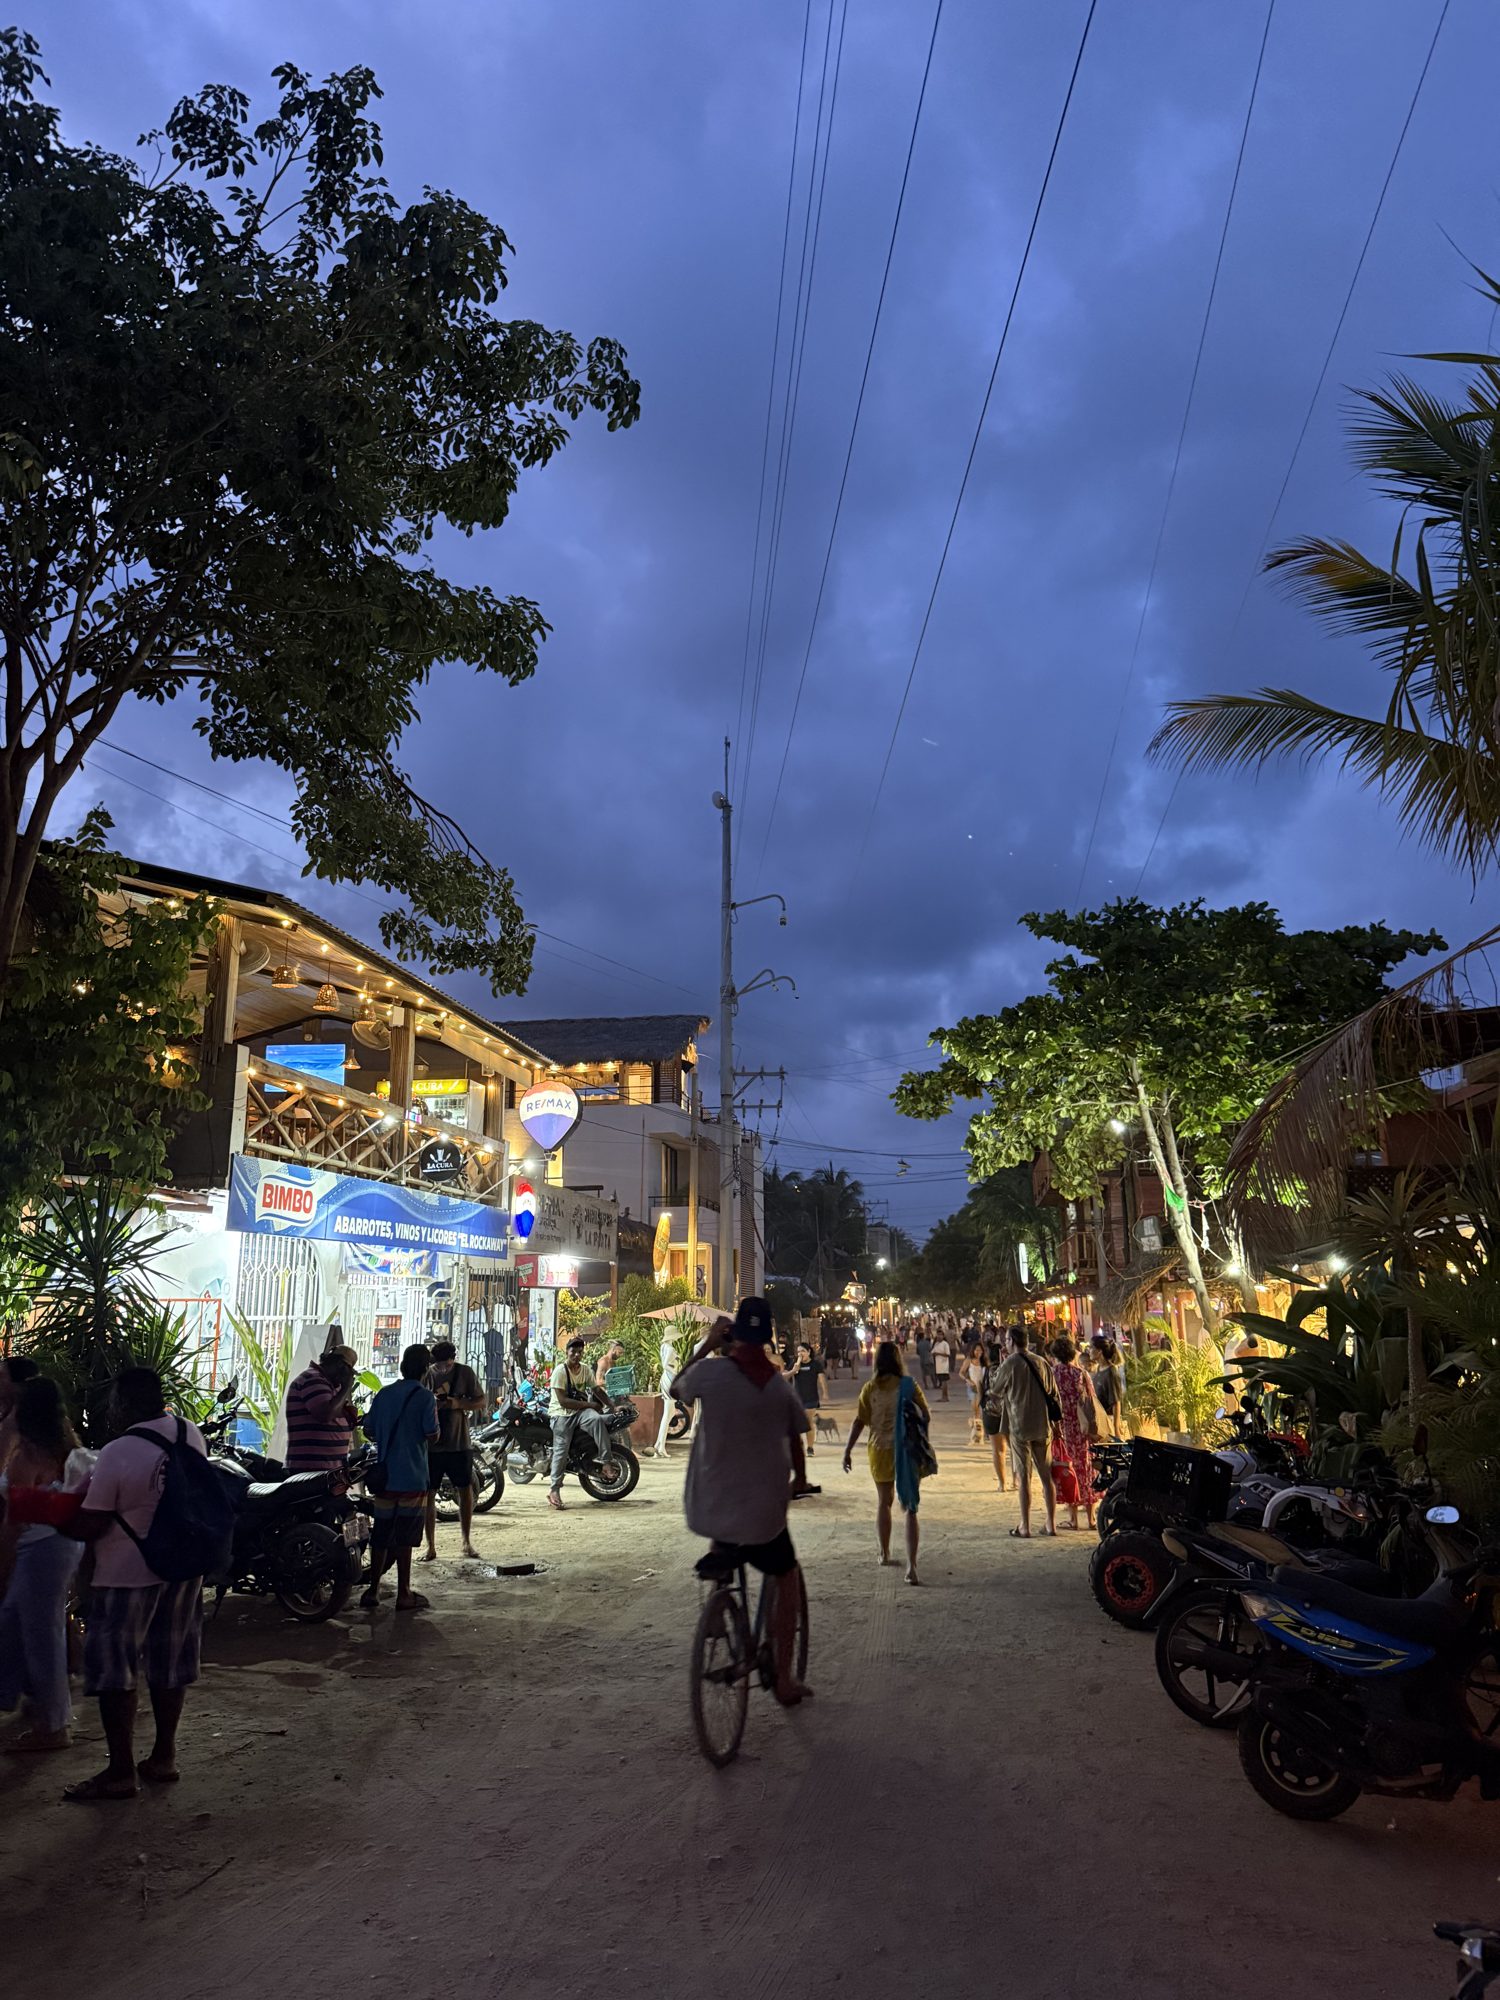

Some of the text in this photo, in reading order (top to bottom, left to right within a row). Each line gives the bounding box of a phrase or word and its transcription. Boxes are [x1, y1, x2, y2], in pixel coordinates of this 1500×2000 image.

[526, 1098, 572, 1112] RE/MAX
[262, 1183, 313, 1214] BIMBO
[334, 1215, 507, 1251] ABARROTES, VINOS Y LICORES "EL ROCKAWAY"
